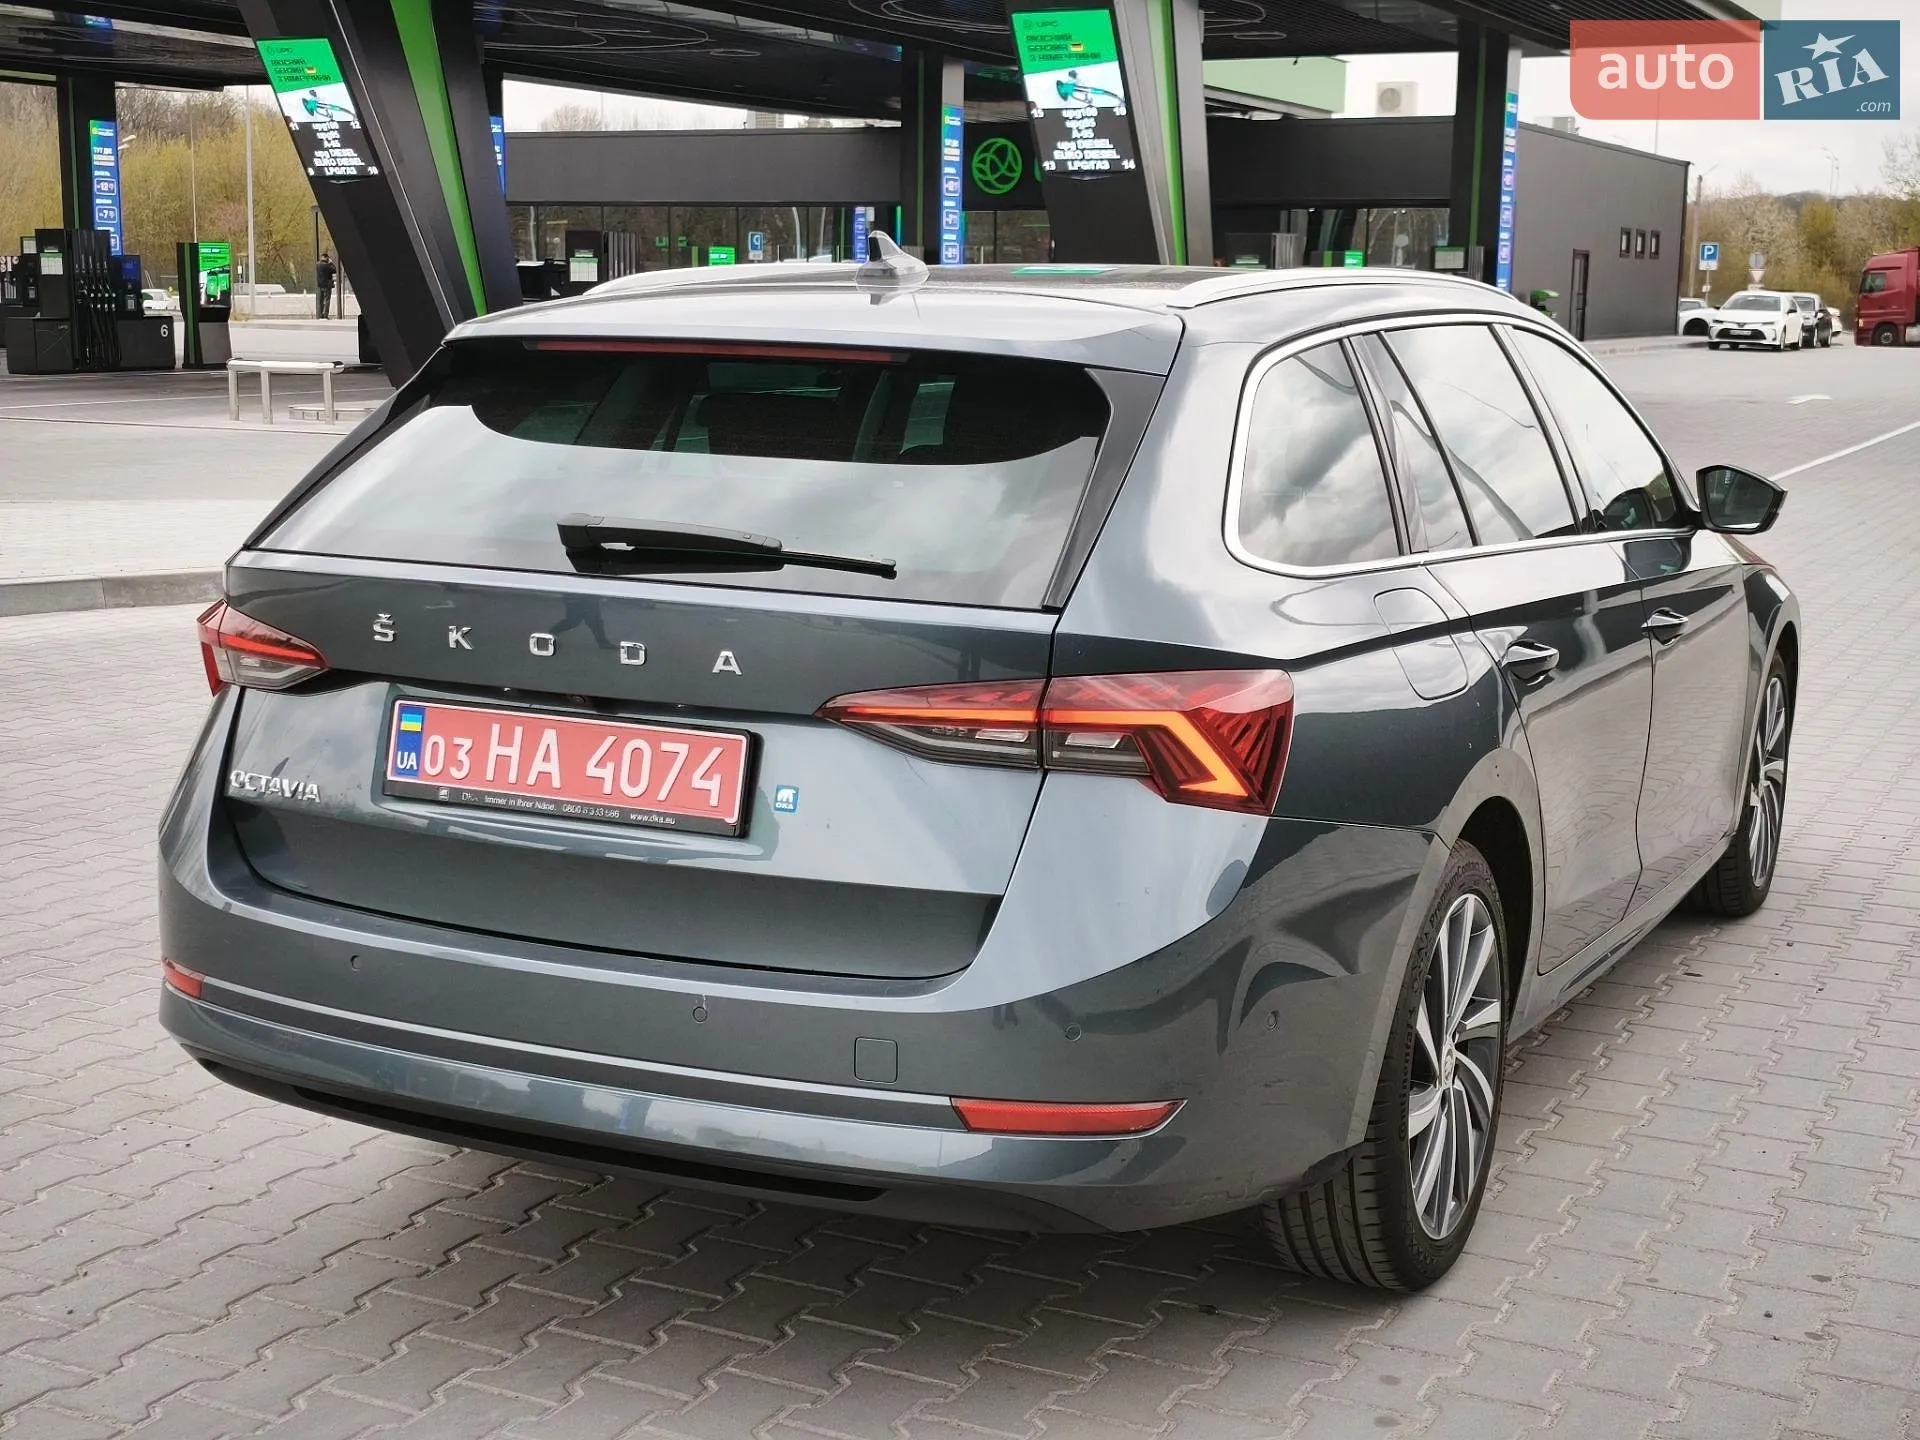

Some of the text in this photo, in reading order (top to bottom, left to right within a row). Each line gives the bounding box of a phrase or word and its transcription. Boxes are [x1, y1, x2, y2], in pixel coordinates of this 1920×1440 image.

[1077, 139, 1114, 149] DIESEL
[329, 148, 358, 157] DIESEL
[1083, 149, 1120, 159] DIESEL
[336, 158, 366, 166] DIESEL
[1703, 245, 1714, 260] P
[160, 324, 168, 337] 6
[373, 613, 743, 676] ŠKODA
[397, 751, 417, 770] UA
[424, 723, 725, 807] 03 HA 4074
[230, 770, 320, 802] OCTAVIA
[508, 797, 516, 807] in
